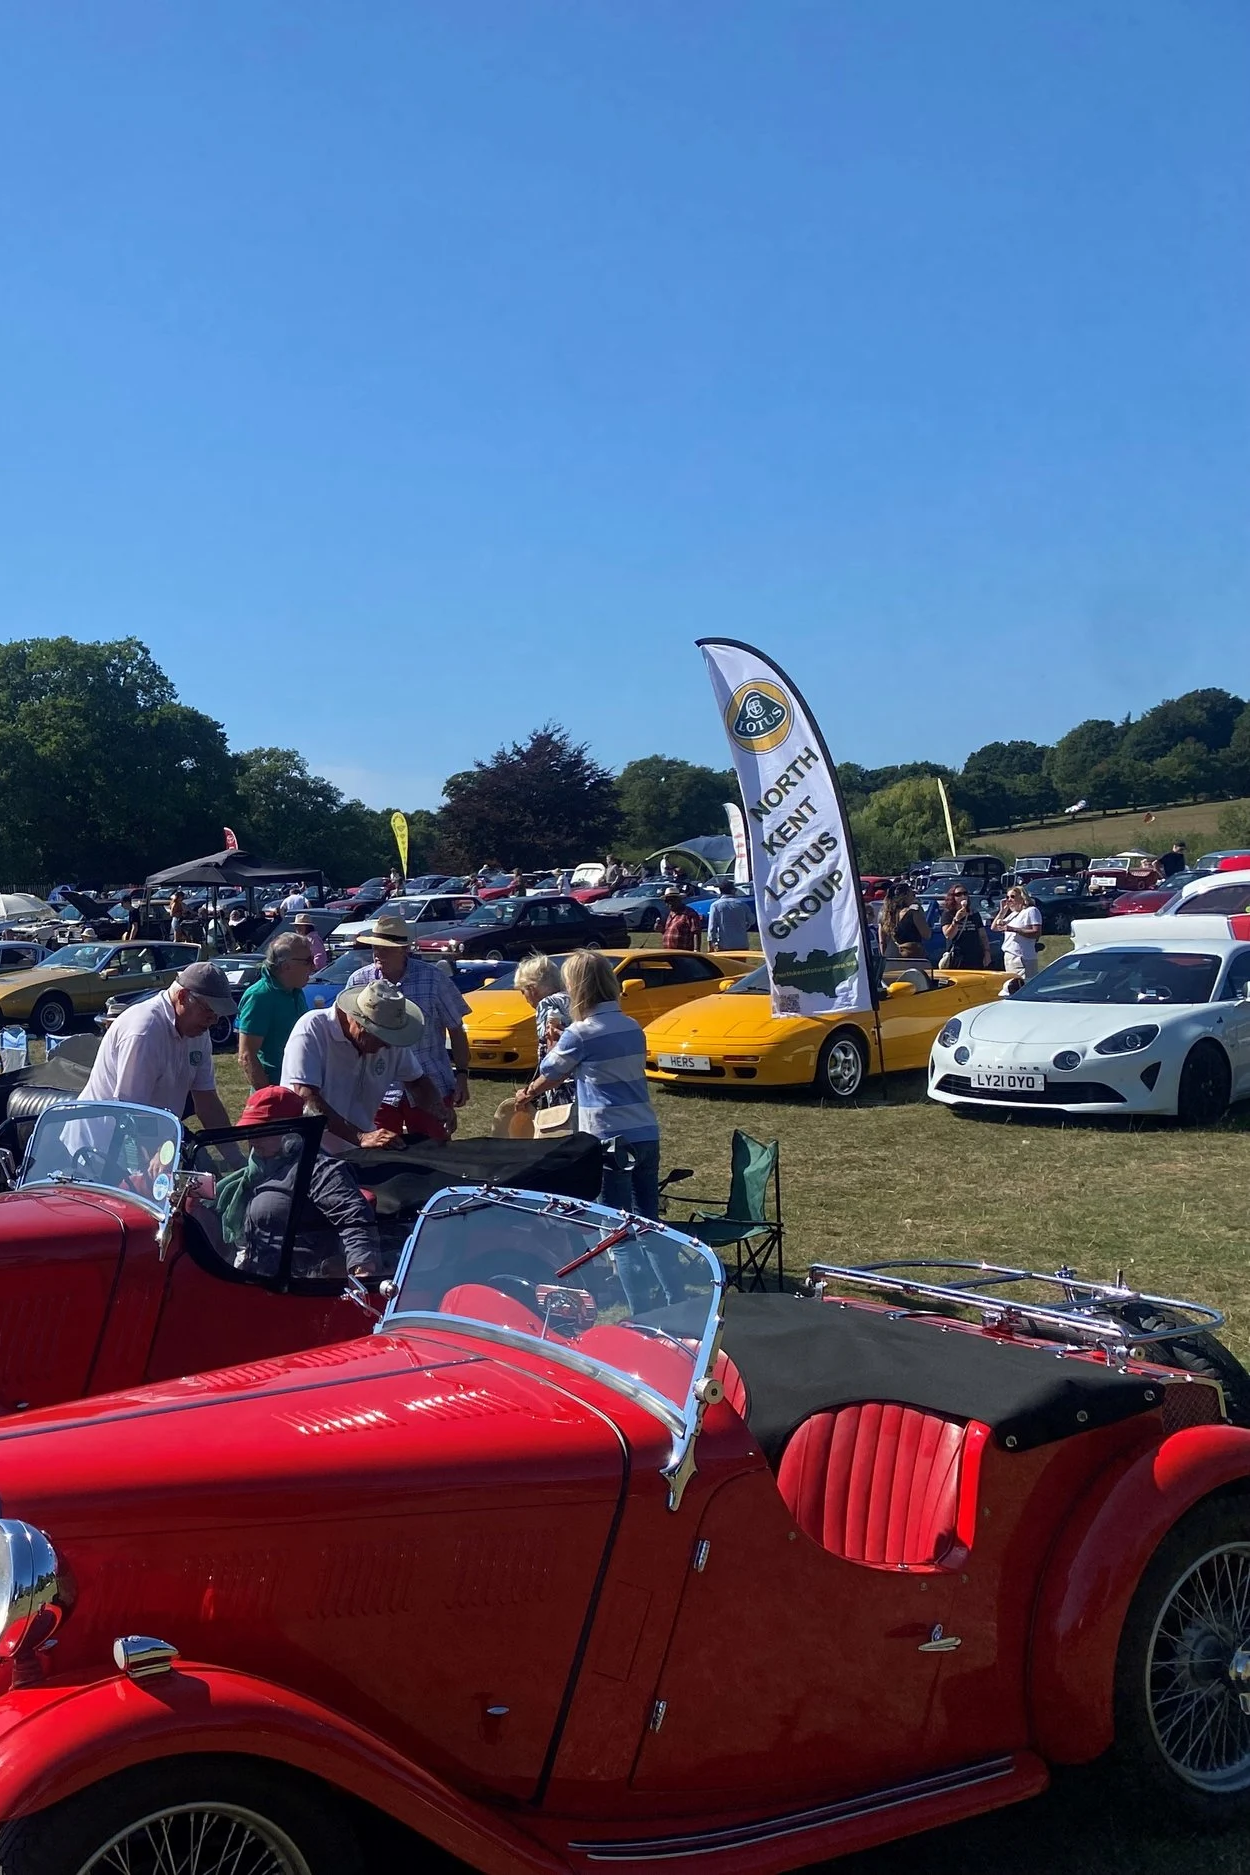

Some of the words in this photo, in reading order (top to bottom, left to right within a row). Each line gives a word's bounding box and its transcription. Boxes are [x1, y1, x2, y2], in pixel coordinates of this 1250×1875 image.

[738, 706, 783, 733] LOTUS
[750, 746, 820, 823] NORTH
[761, 795, 818, 857] KENT
[765, 831, 839, 902] LOTUS
[768, 869, 844, 940] GROUP
[670, 1056, 695, 1068] HERS
[977, 1074, 1004, 1087] LY21
